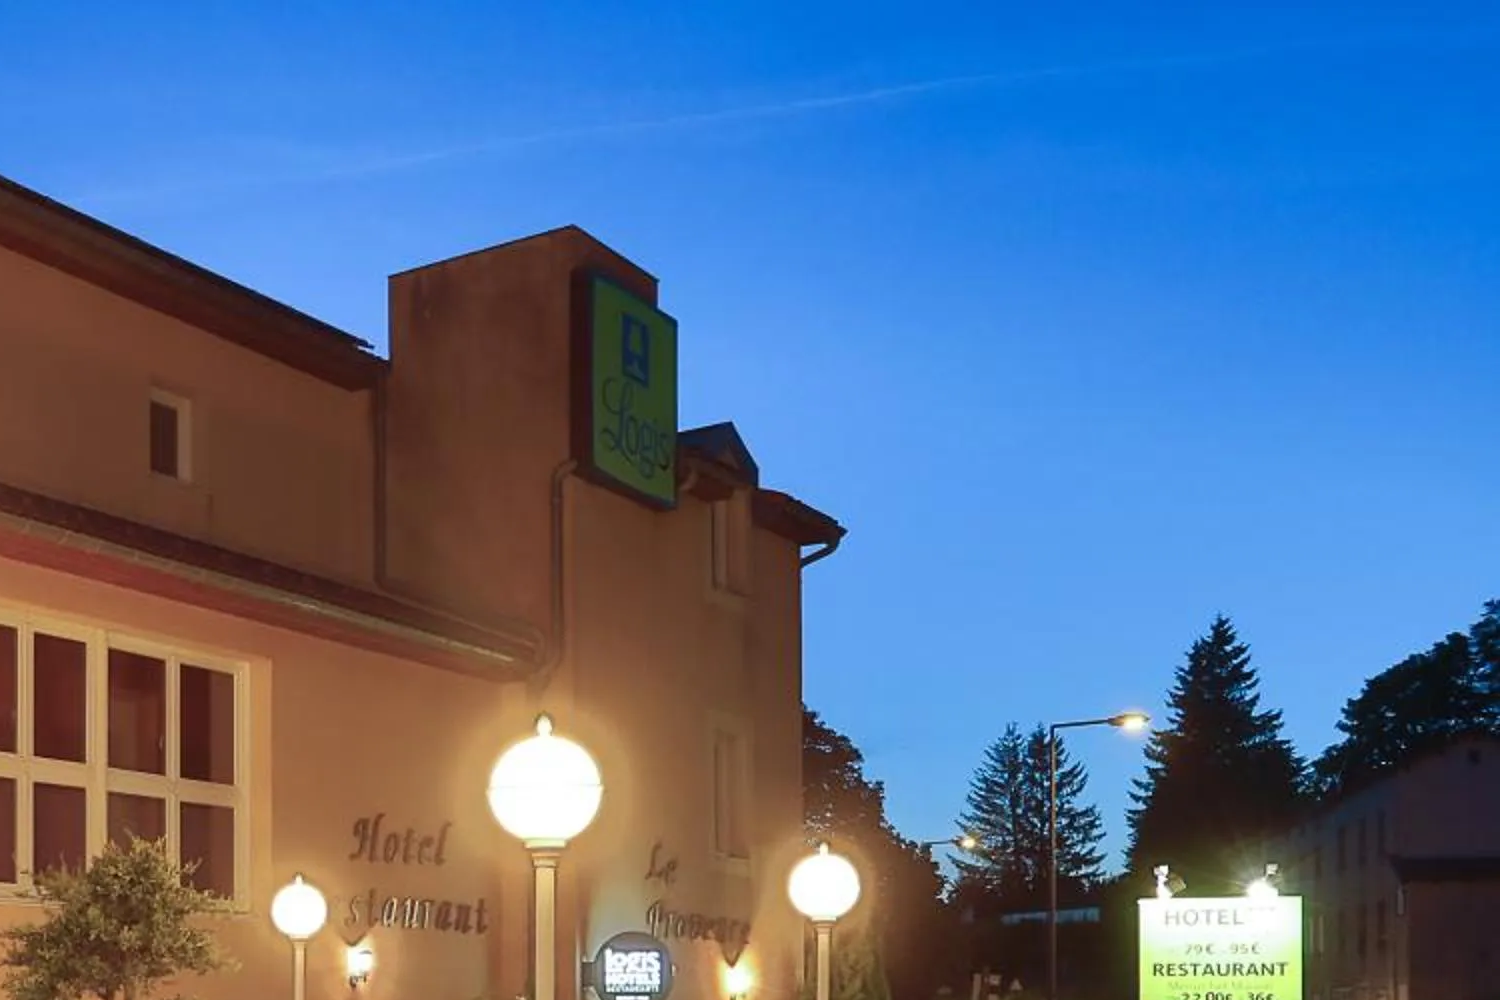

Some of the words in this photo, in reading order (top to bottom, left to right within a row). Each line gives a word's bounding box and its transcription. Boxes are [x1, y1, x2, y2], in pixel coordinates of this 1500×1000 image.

[599, 376, 671, 479] Logis
[348, 812, 453, 866] Hotel
[644, 841, 678, 887] Le
[342, 888, 489, 936] staurant
[1164, 908, 1245, 927] HOTEL
[1152, 961, 1289, 977] RESTAURANT
